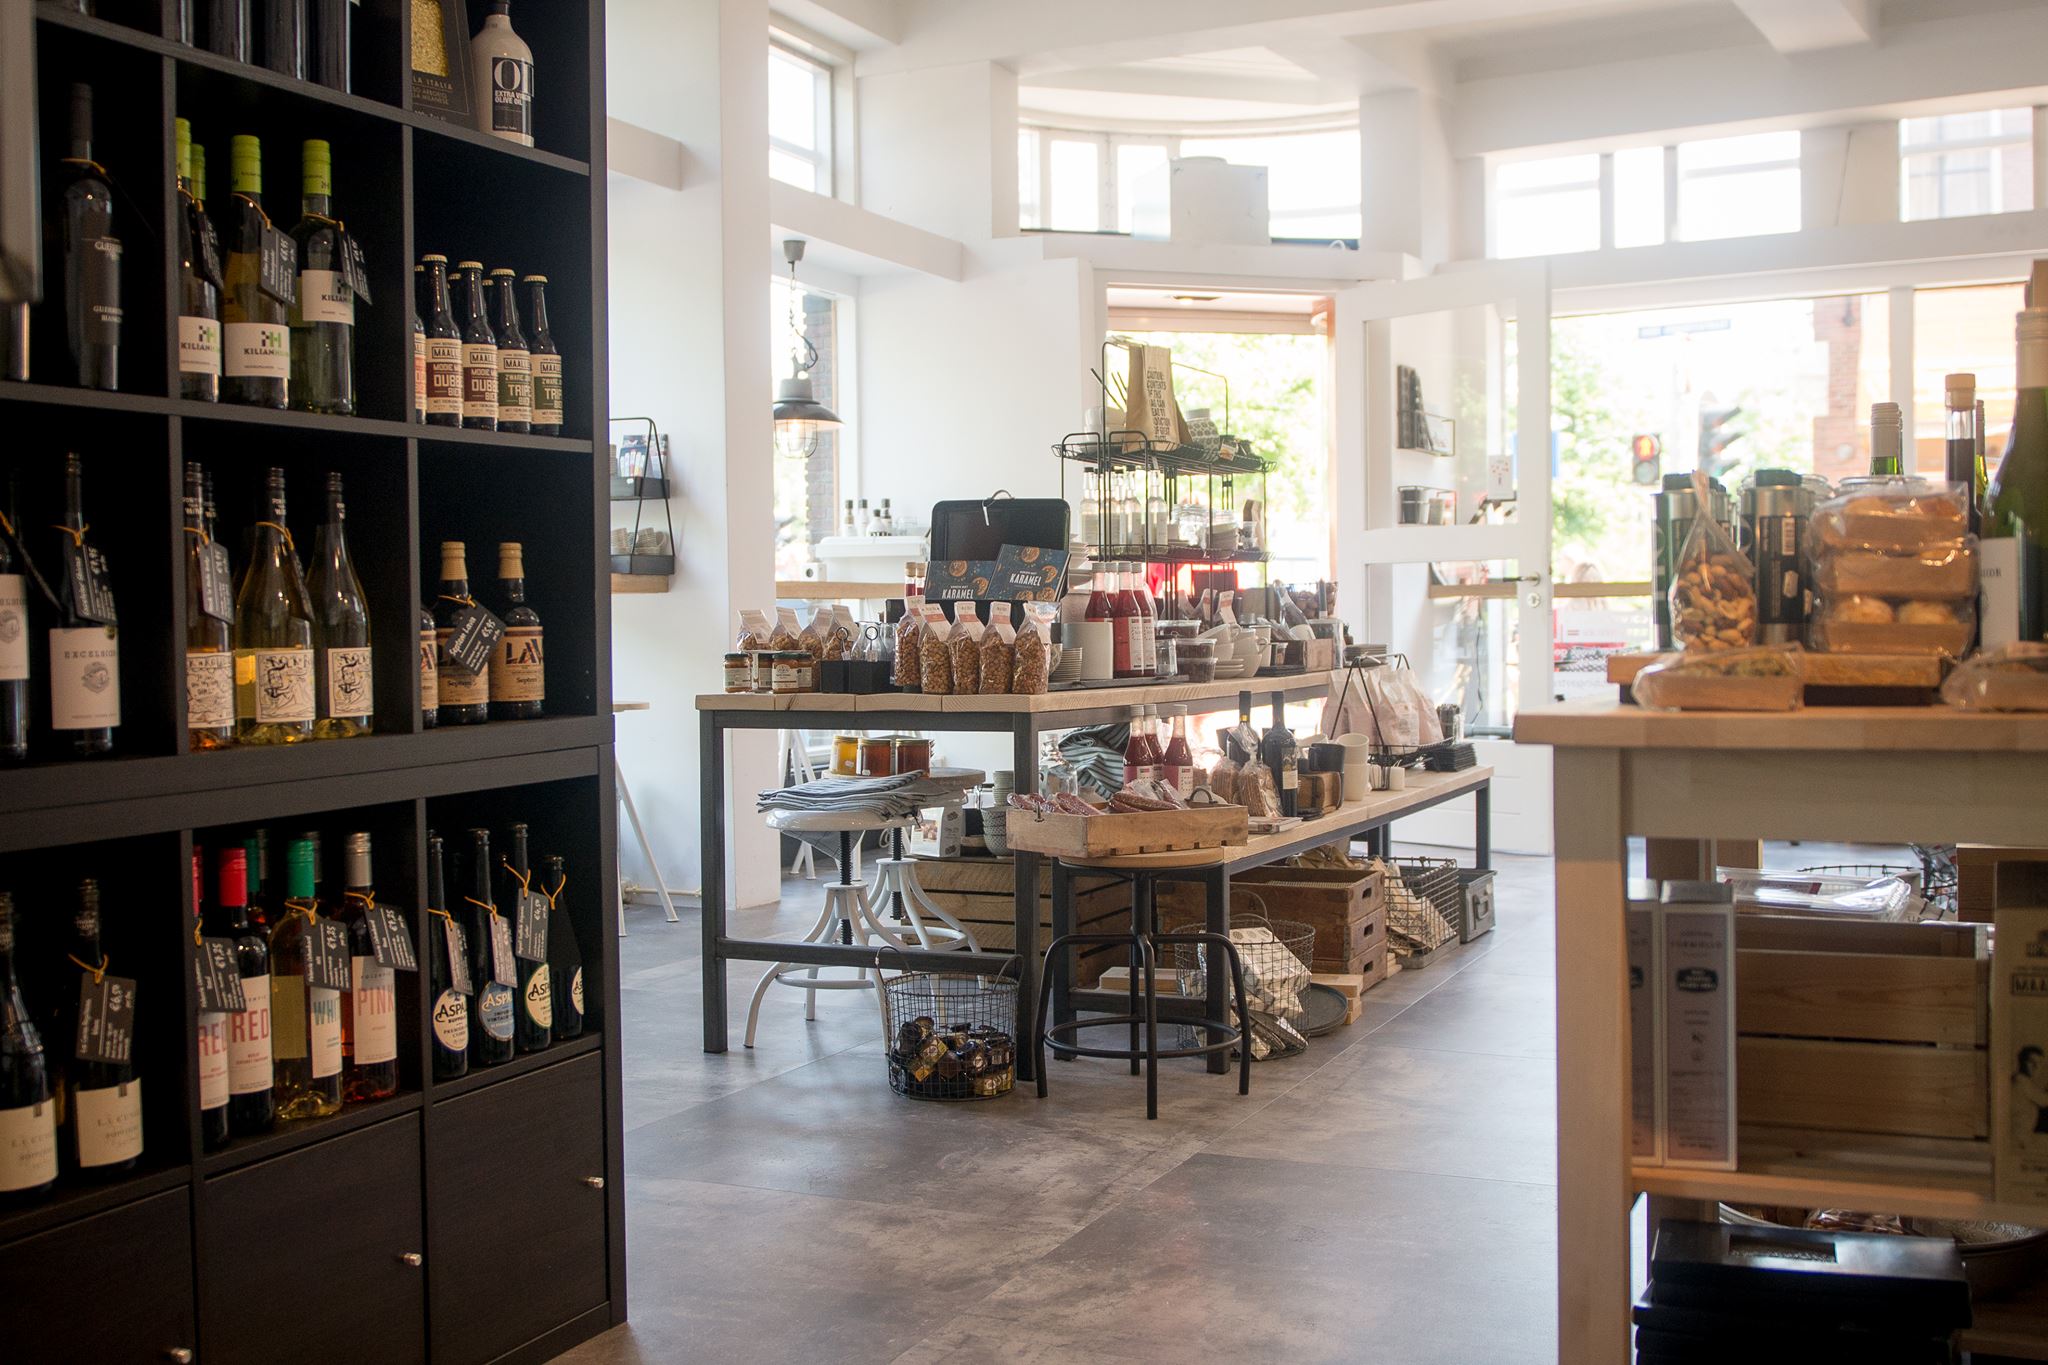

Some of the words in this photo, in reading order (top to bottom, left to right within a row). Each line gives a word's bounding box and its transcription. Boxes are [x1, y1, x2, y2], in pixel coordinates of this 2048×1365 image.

[1009, 573, 1043, 587] KARAMEL
[942, 589, 974, 600] KARAMEL
[231, 1008, 269, 1042] RED
[199, 1020, 226, 1056] RED
